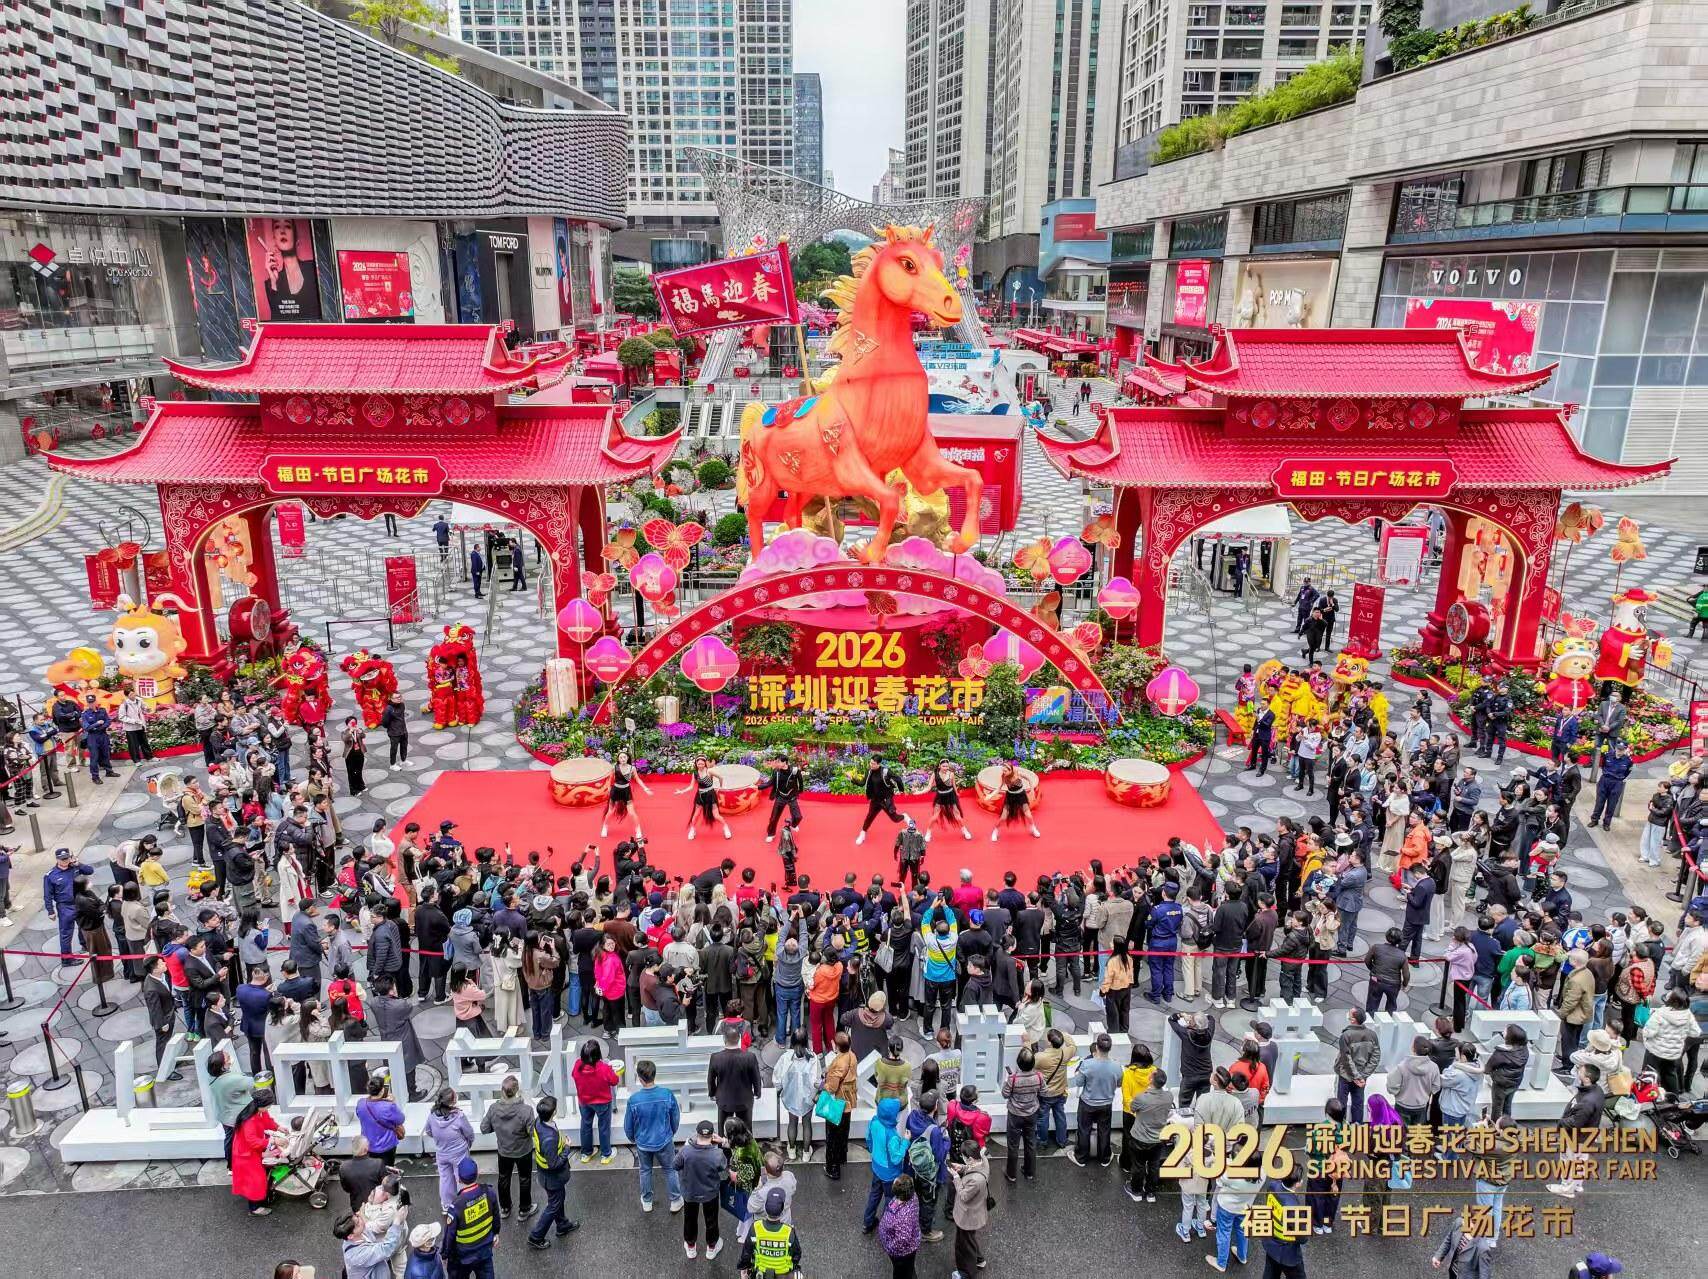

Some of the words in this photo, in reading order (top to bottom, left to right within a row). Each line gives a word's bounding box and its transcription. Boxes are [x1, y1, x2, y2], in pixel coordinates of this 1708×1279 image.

[488, 235, 503, 248] TOM
[503, 236, 519, 249] FORD
[68, 245, 152, 268] 卓悦中心
[1431, 268, 1523, 286] VOLVO
[670, 271, 779, 315] 福馬迎春
[1269, 289, 1284, 305] POP
[395, 580, 410, 588] 入口
[1358, 610, 1375, 619] 入口
[815, 631, 906, 668] 2026
[749, 674, 986, 713] 深圳迎春花市
[744, 715, 769, 726] 2026
[761, 1249, 784, 1257] POLICE
